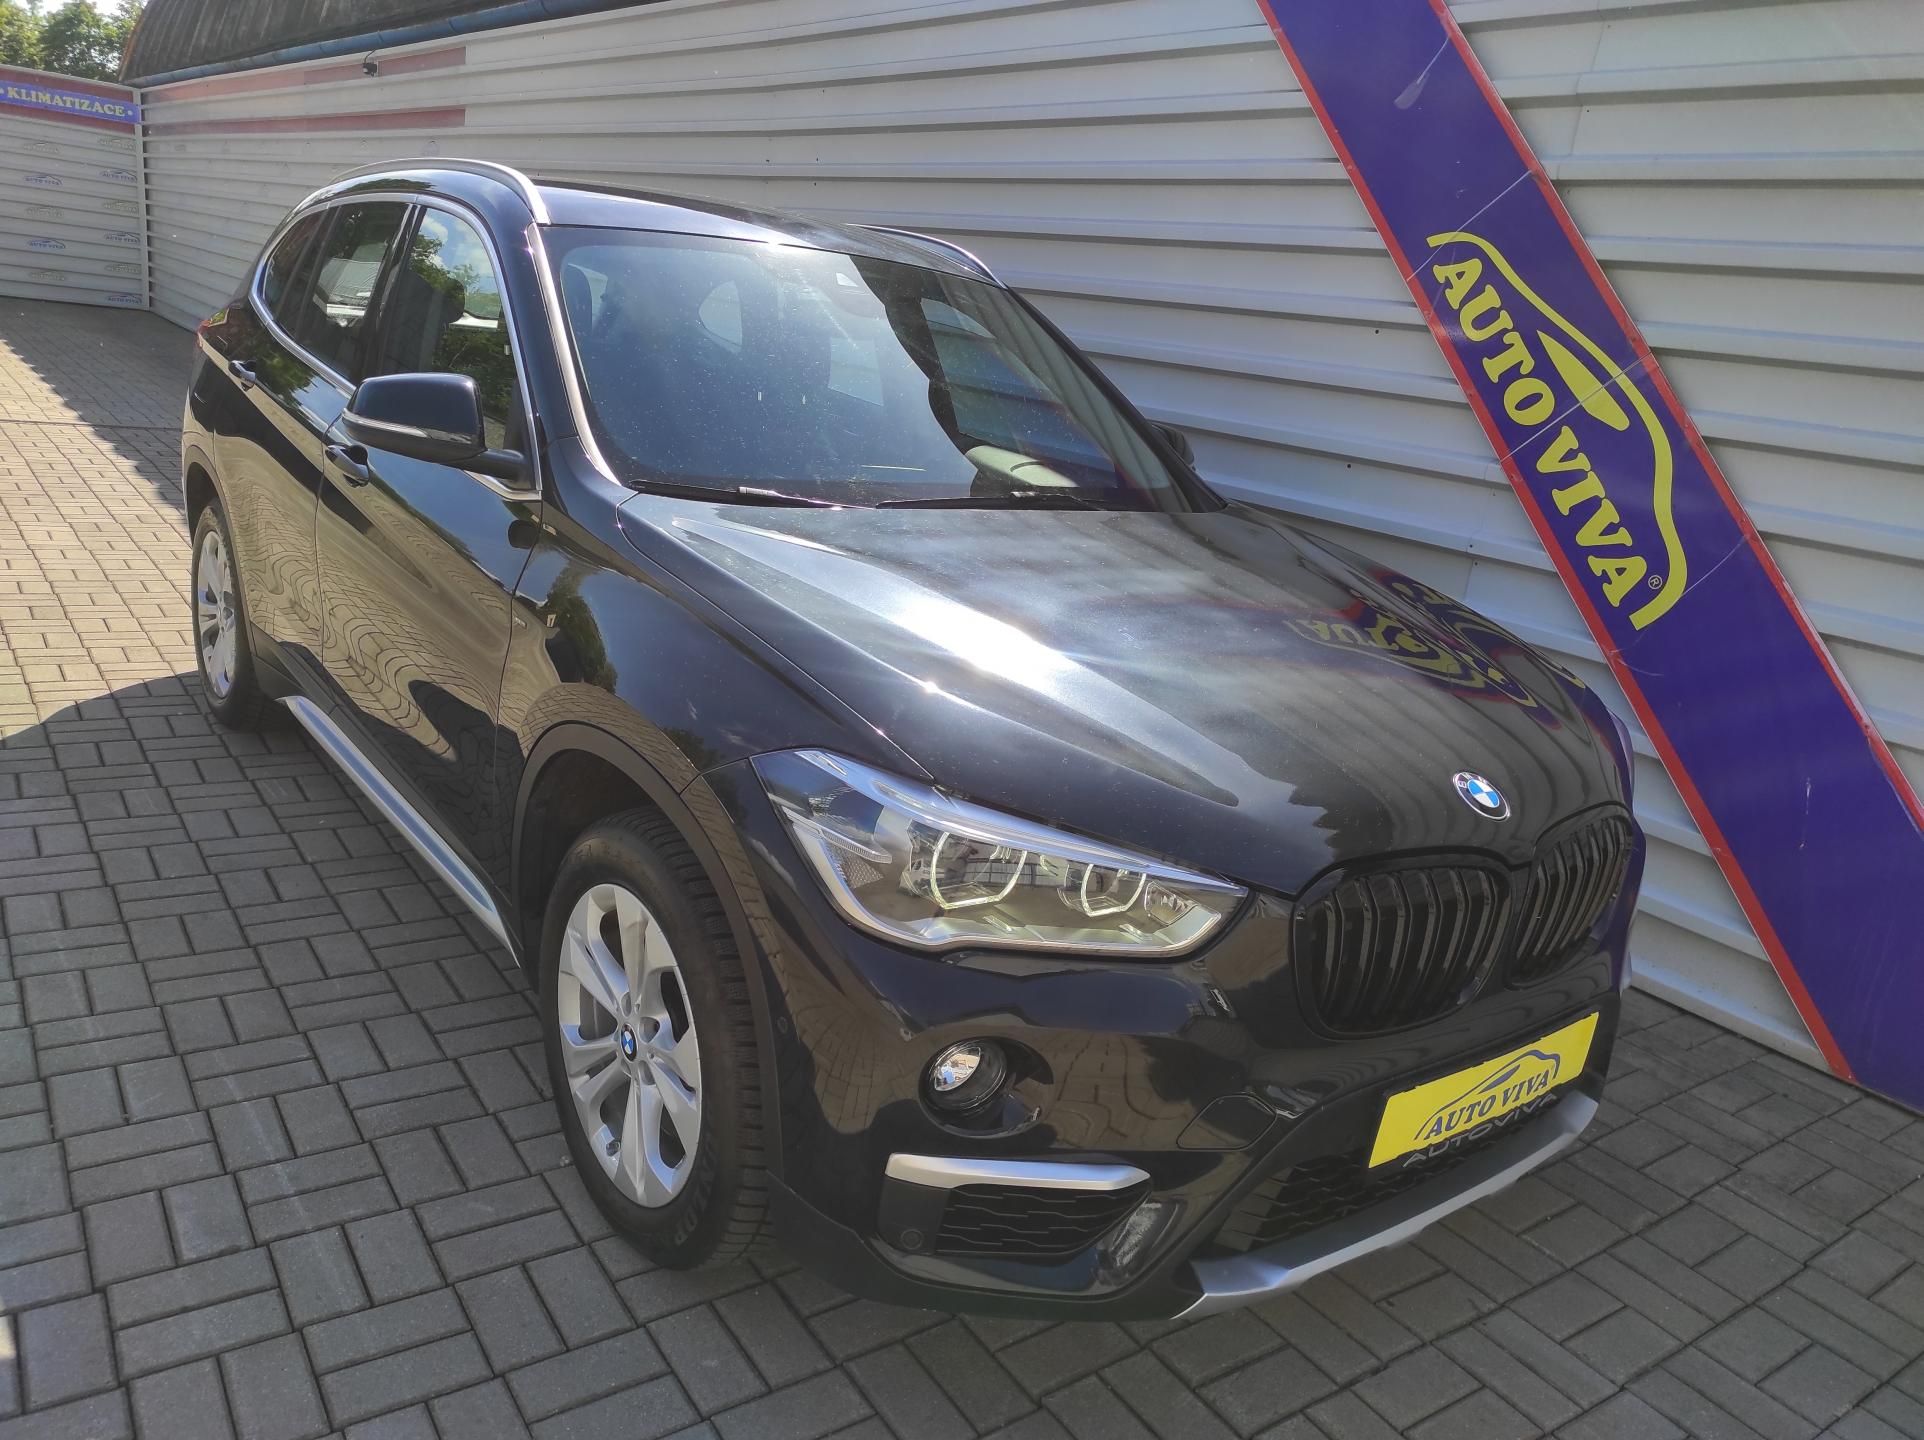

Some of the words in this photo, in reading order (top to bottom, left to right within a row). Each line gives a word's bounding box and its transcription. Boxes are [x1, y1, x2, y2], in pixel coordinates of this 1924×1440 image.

[7, 86, 125, 117] KLIMATIZACE
[1433, 258, 1555, 427] AUTO
[1536, 426, 1648, 608] VIVA
[1424, 1094, 1496, 1140] AUTO
[1502, 1070, 1550, 1108] VIVA
